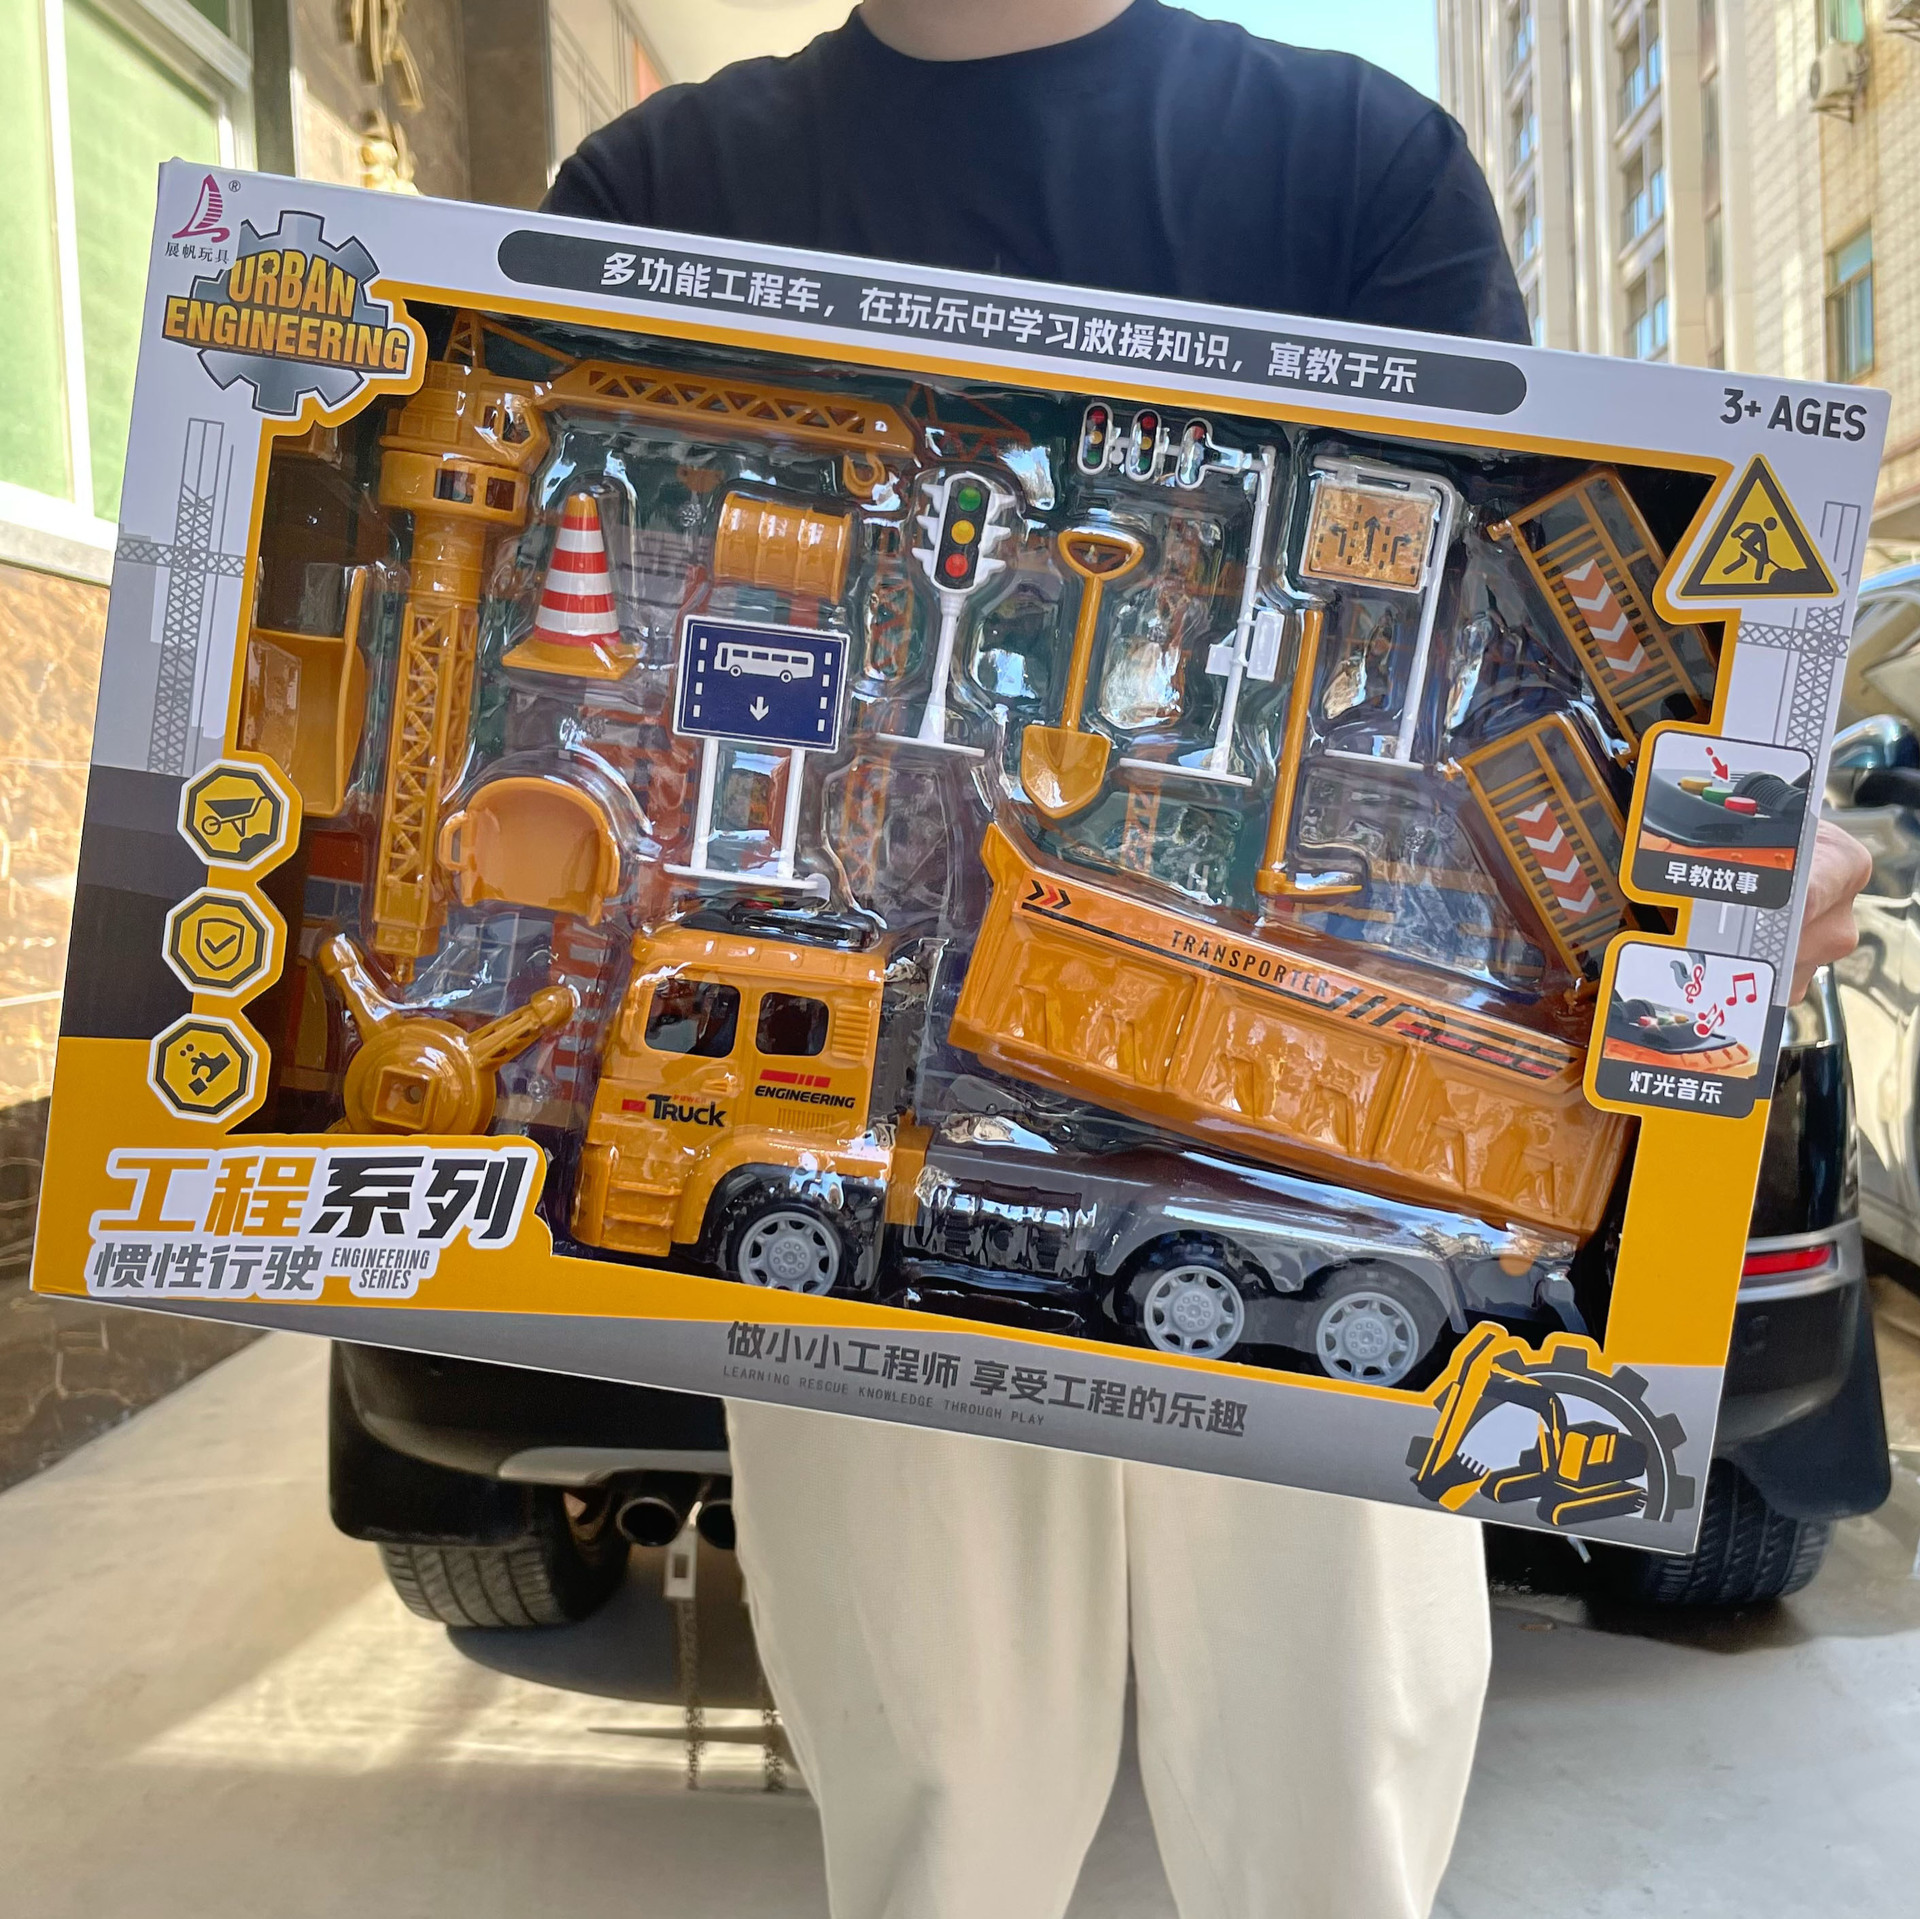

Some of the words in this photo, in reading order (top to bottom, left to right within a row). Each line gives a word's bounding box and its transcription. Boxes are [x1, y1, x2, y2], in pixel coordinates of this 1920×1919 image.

[164, 241, 230, 265] 展帆玩具
[227, 249, 358, 318] URBAN
[163, 296, 409, 373] ENGINEERING
[1719, 387, 1762, 425] 3+
[1767, 395, 1867, 441] AGES
[1664, 860, 1760, 895] 早教故事
[1171, 930, 1330, 998] TRANSPORTER
[754, 1085, 856, 1109] ENGINEERING
[1628, 1070, 1723, 1105] 灯光音乐
[98, 1155, 528, 1239] 工程系列
[93, 1242, 321, 1291] 惯性行驶
[331, 1247, 430, 1269] ENGINEERING
[359, 1269, 411, 1289] SERIES
[723, 1365, 790, 1386] LEARNING
[799, 1377, 848, 1395] RESCUE
[858, 1386, 934, 1408] KNOWLEDGE
[944, 1399, 1001, 1419] THROUGH
[1010, 1405, 1045, 1426] PLAY
[727, 1320, 961, 1388] 做小小工程师
[970, 1358, 1249, 1437] 享受工程的乐趣
